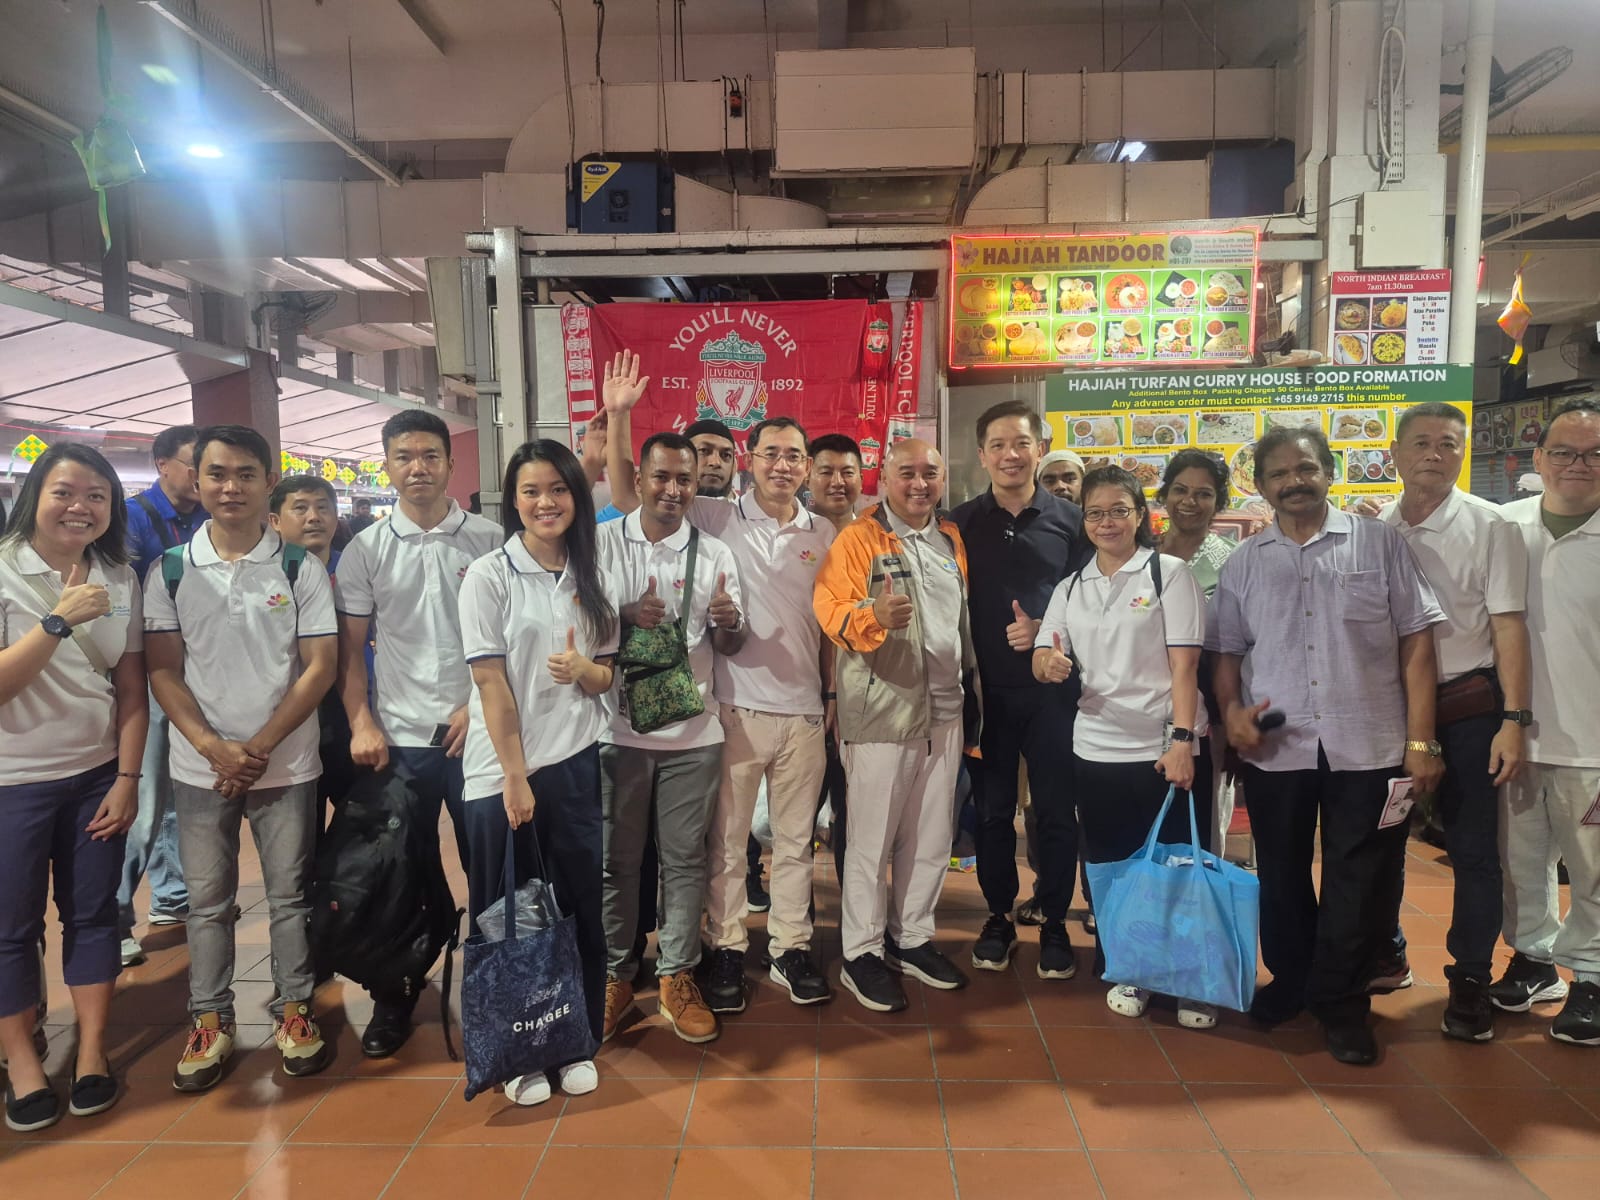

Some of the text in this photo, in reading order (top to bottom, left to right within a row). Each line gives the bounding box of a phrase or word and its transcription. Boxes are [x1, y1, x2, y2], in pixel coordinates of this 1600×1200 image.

[983, 244, 1165, 265] HAJIAH TANDOOR
[1367, 274, 1397, 282] INDIAN
[1399, 273, 1446, 281] BREAKFAST
[669, 307, 797, 358] YOU'LL NEVER
[709, 368, 755, 379] LIVERPOOL
[1069, 369, 1447, 391] HAJIAH TURFAN CURRY HOUSE FOOD FORMATION
[662, 377, 690, 389] EST.
[771, 379, 804, 391] 1892
[1128, 389, 1167, 397] Additional
[1356, 384, 1390, 392] Available
[897, 389, 913, 414] FC
[1112, 392, 1407, 409] Any advance order must contact +65 9149 2715 this number
[512, 1003, 571, 1033] CHAGEE
